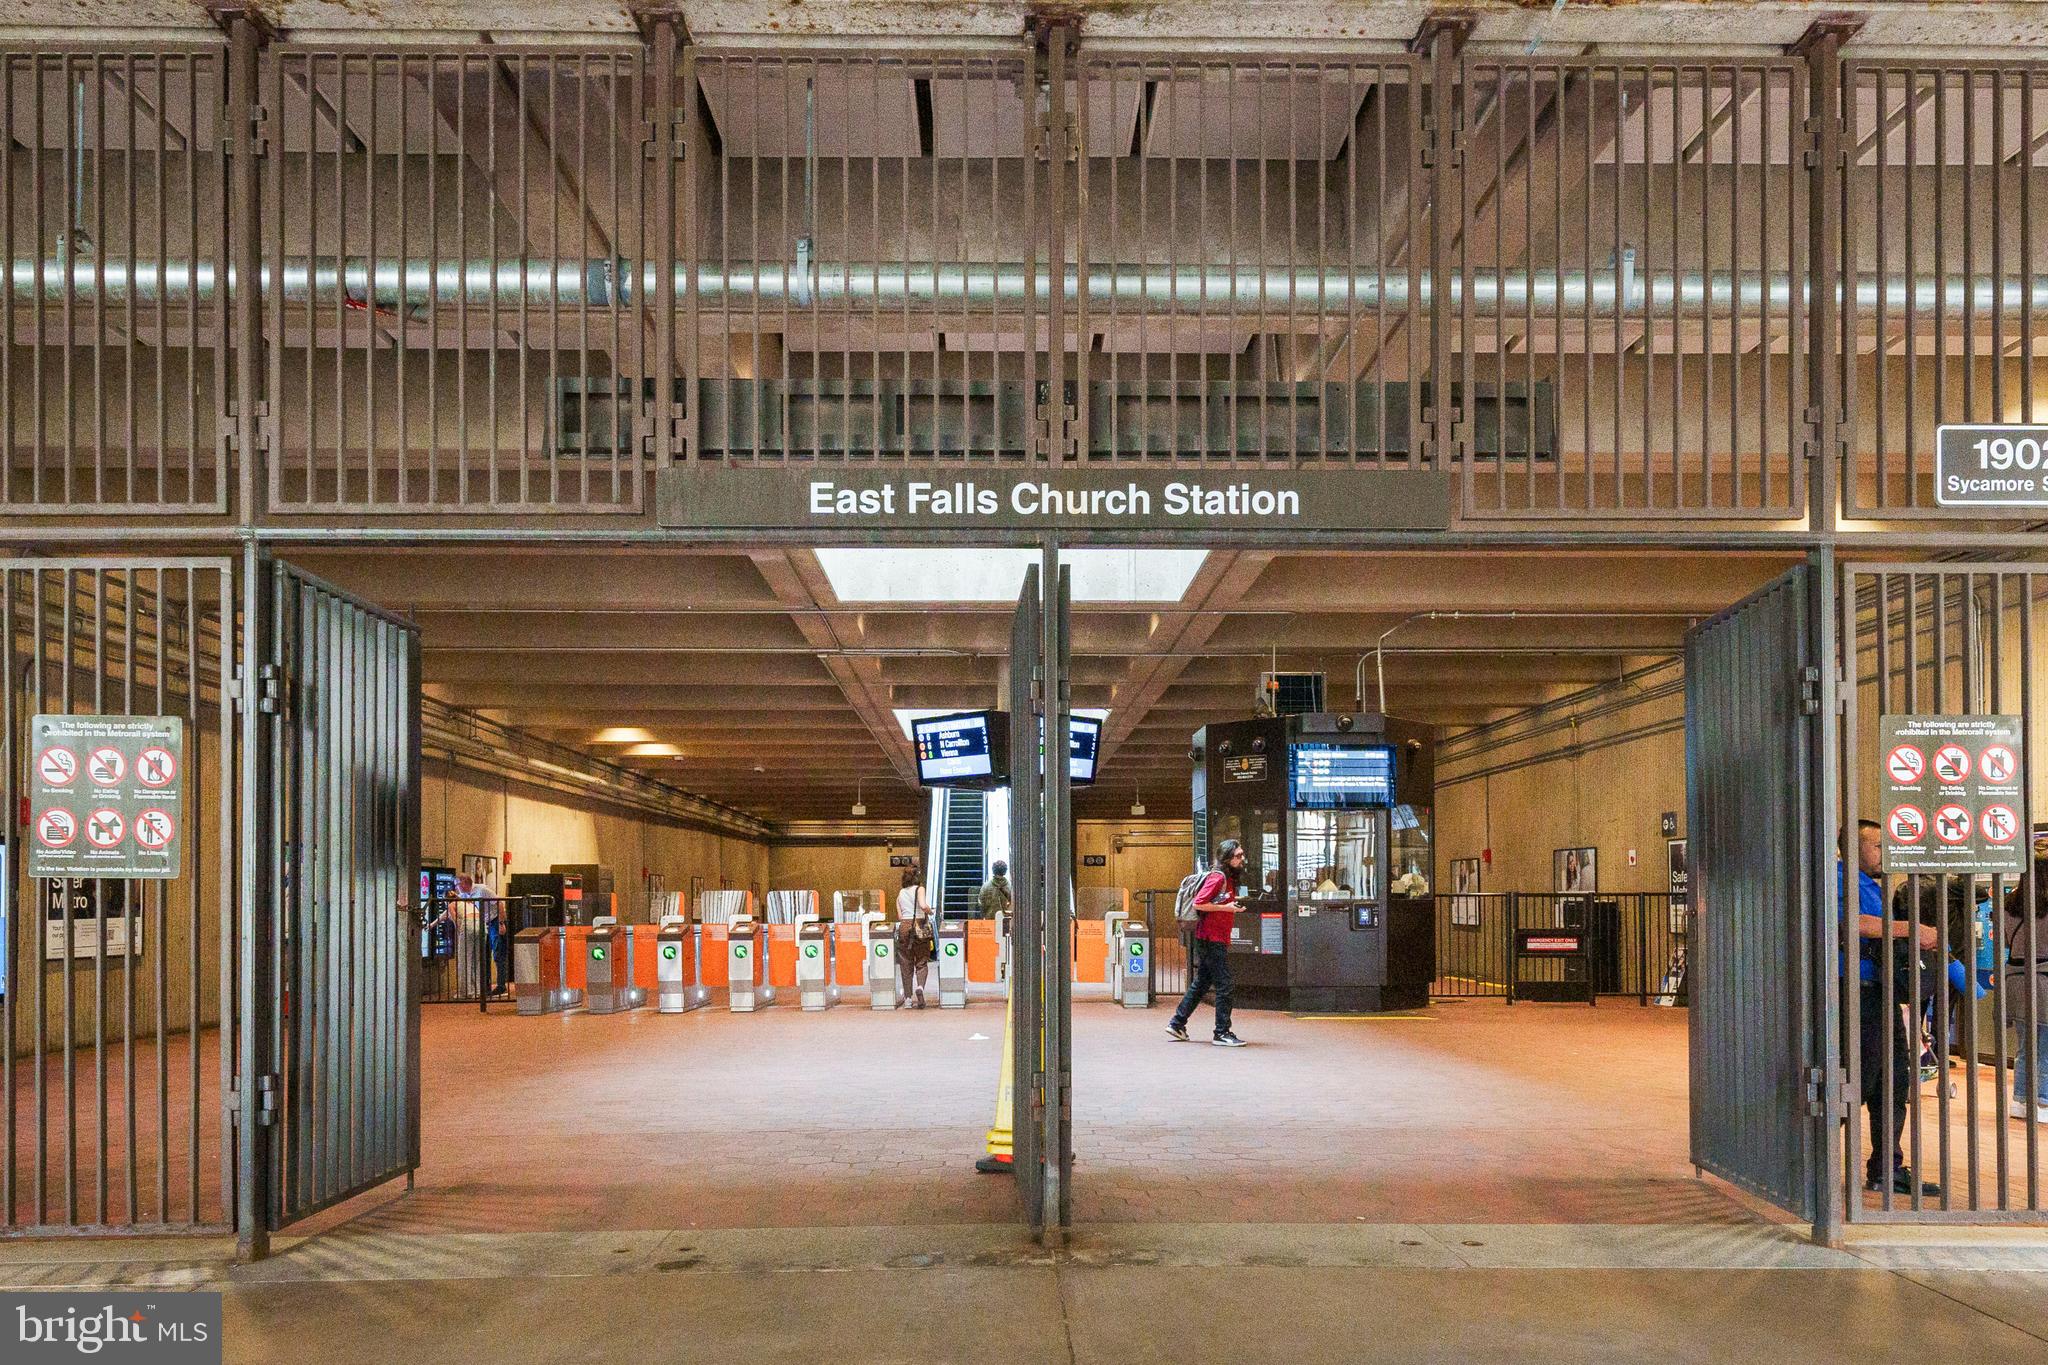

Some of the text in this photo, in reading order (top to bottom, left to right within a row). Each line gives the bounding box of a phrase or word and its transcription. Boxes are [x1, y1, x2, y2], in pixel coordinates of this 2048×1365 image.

[1973, 438, 2048, 470] 190
[1948, 475, 2034, 493] Sycamore
[810, 482, 1300, 515] East Falls Church Station
[77, 722, 112, 731] following
[127, 723, 153, 731] strictly
[1923, 720, 1956, 729] following
[1971, 721, 1995, 729] strictly
[939, 731, 960, 740] Ashburn
[983, 736, 987, 744] 3
[940, 749, 959, 757] Vienna
[983, 745, 988, 753] 7
[1673, 871, 1687, 882] Safe
